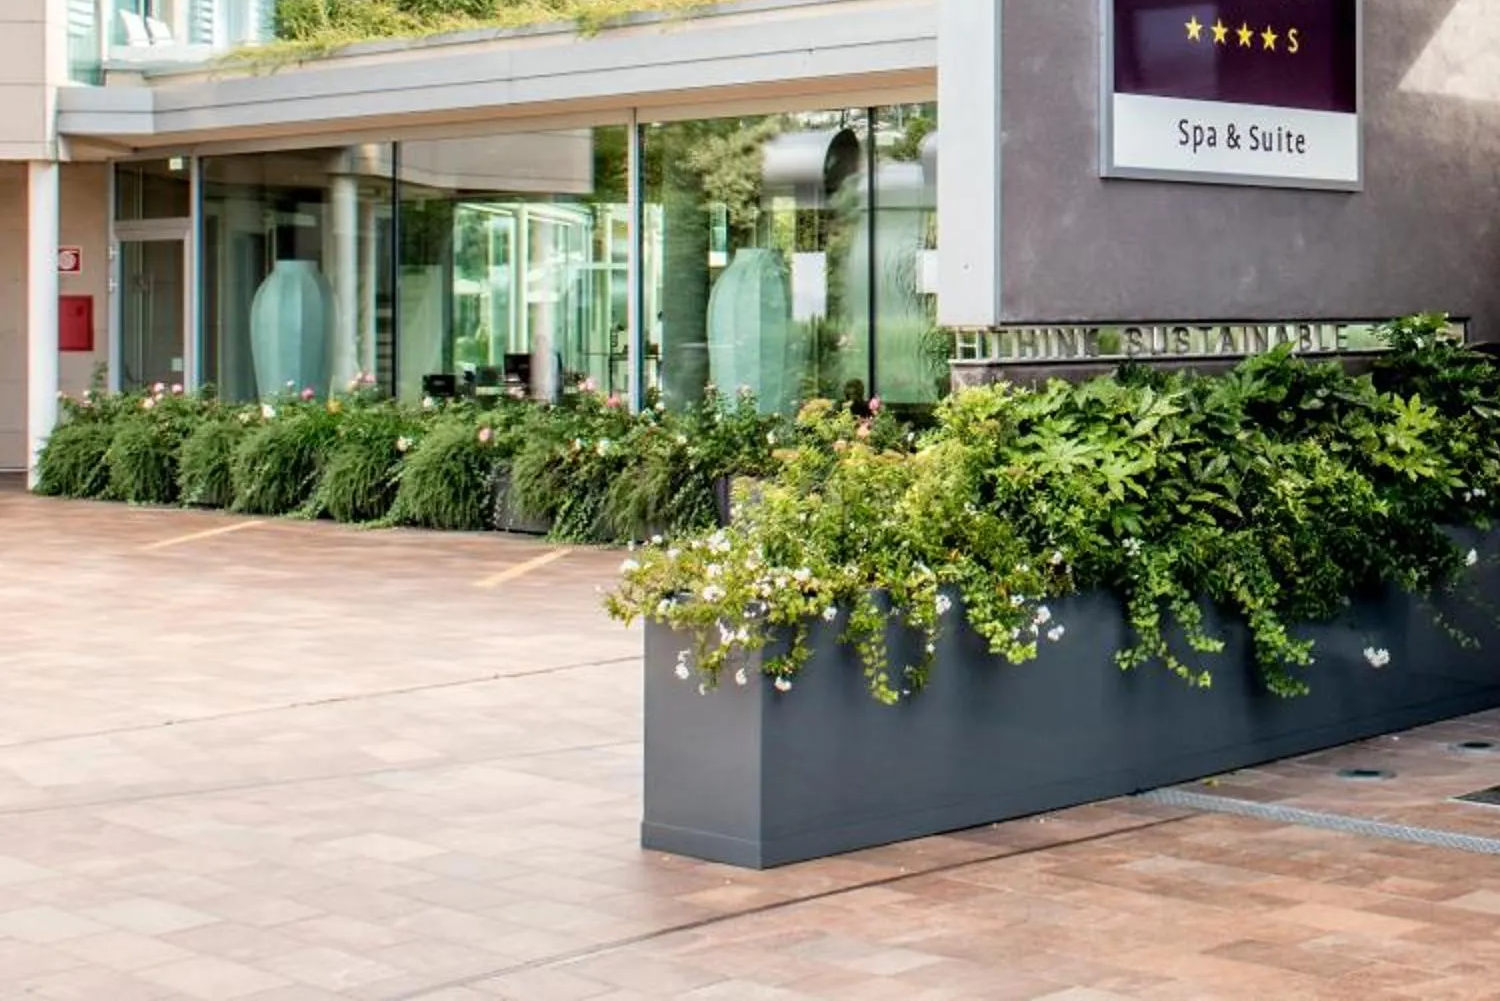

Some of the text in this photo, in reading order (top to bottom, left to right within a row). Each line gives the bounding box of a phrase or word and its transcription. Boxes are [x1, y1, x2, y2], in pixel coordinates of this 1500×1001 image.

[1178, 119, 1305, 154] Spa & Suite
[992, 326, 1099, 359] THINK
